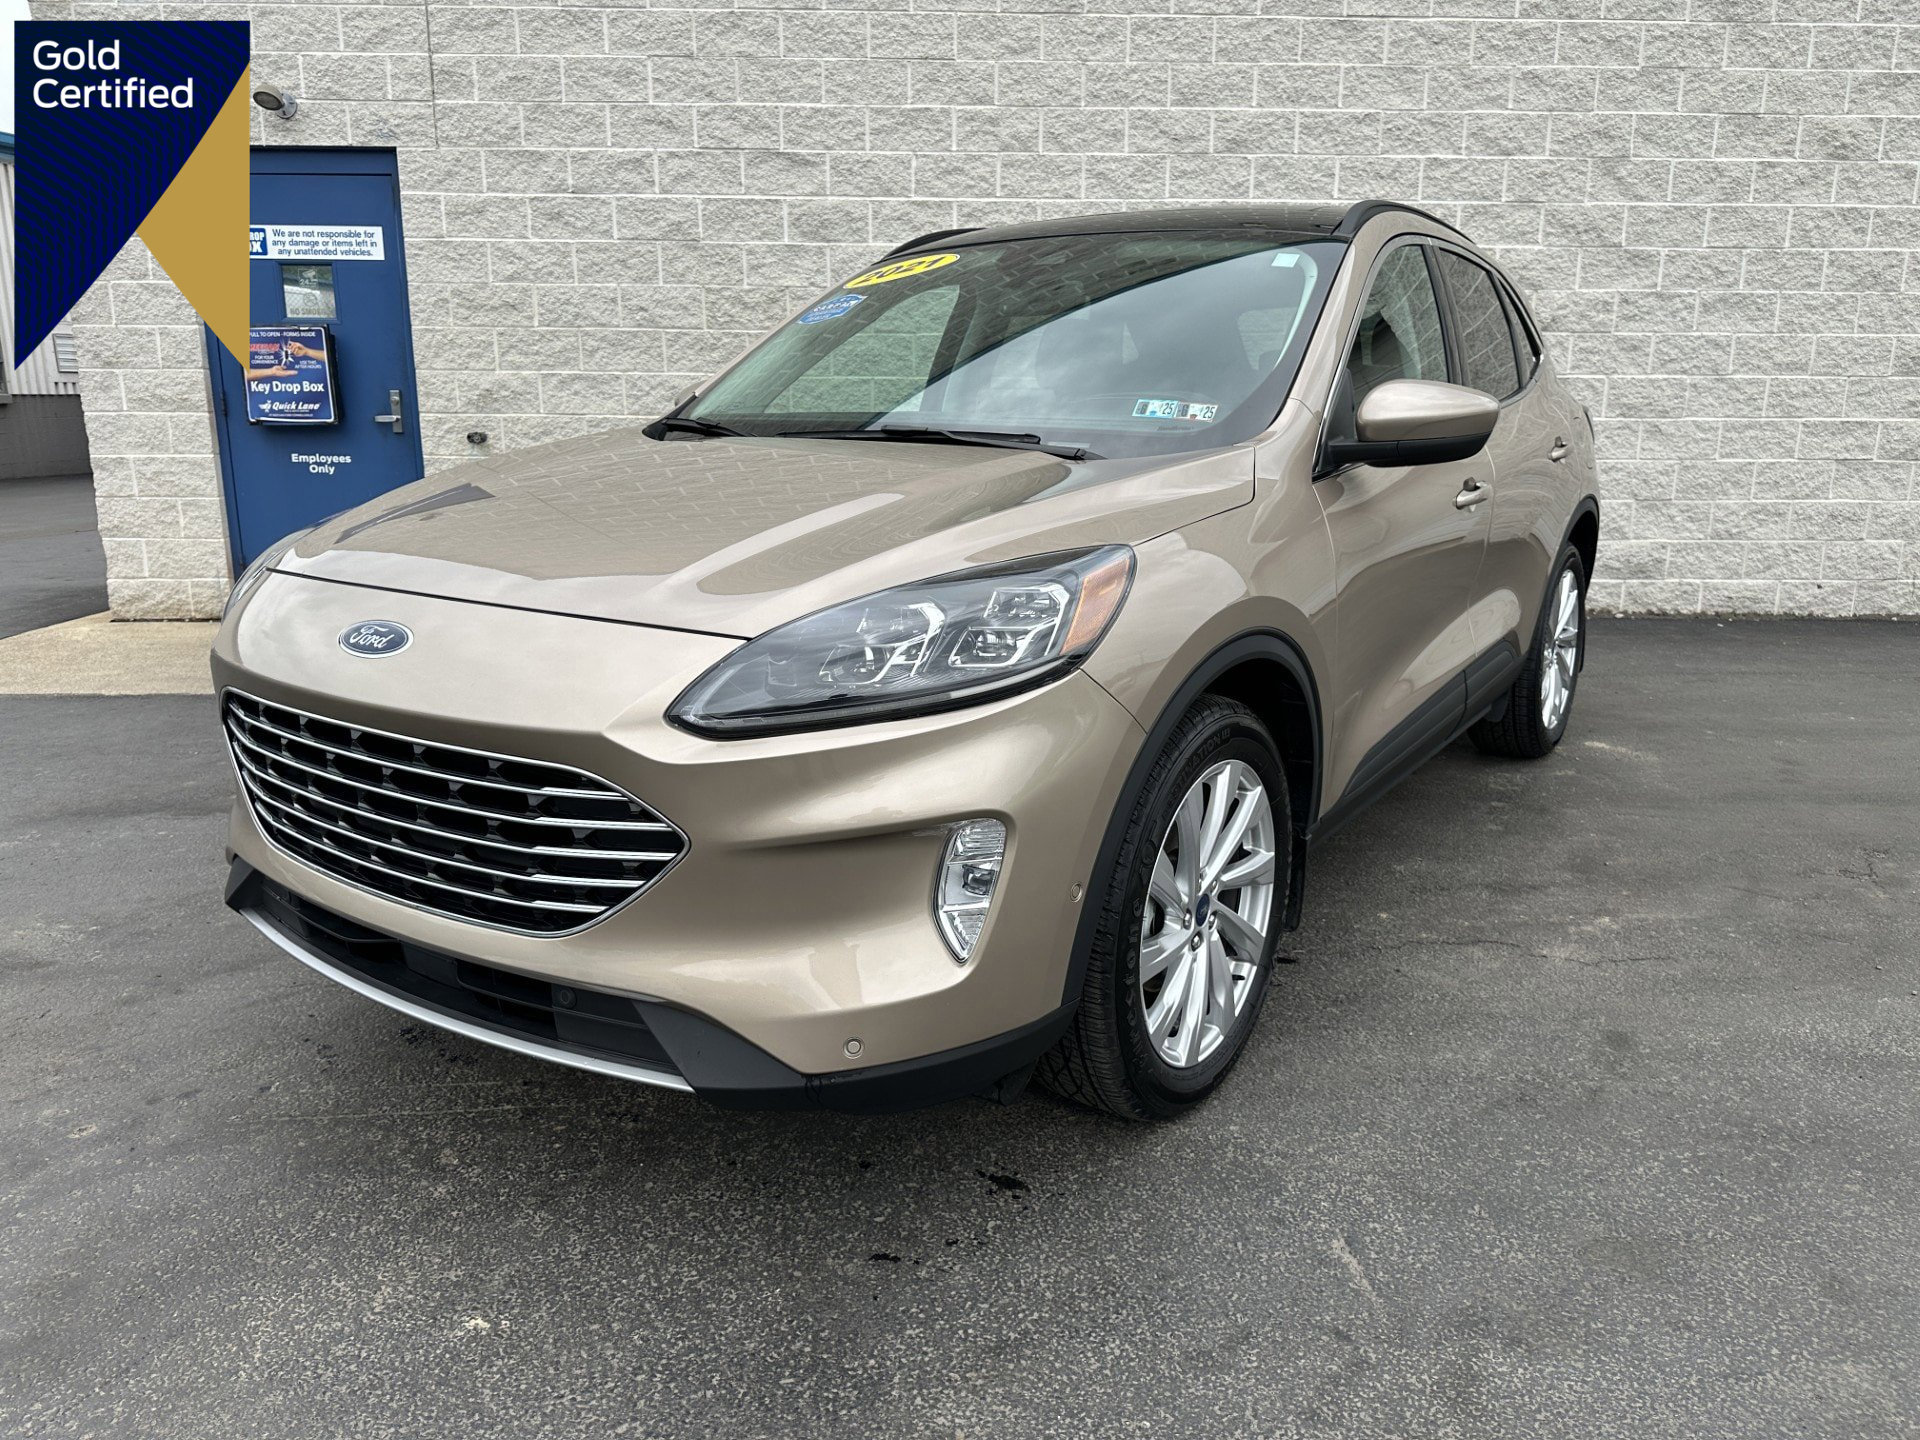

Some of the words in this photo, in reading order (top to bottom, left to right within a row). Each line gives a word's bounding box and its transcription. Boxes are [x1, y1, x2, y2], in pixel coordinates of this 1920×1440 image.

[272, 228, 286, 238] We
[287, 230, 301, 238] are
[302, 230, 315, 238] not
[317, 229, 362, 240] responsible
[363, 230, 375, 239] for
[272, 239, 287, 248] any
[288, 239, 320, 249] damage
[331, 239, 354, 248] items
[354, 239, 369, 248] left
[369, 239, 378, 248] in
[277, 248, 292, 257] any
[293, 248, 338, 256] unattended
[339, 248, 374, 257] vehicles.
[852, 255, 946, 287] 2021
[250, 381, 271, 395] Key
[272, 381, 301, 395] Drop
[302, 381, 324, 392] Box
[272, 401, 297, 410] Quick
[298, 401, 320, 410] Lane
[291, 453, 352, 464] Employees
[309, 464, 336, 475] Only
[349, 624, 395, 649] Ford
